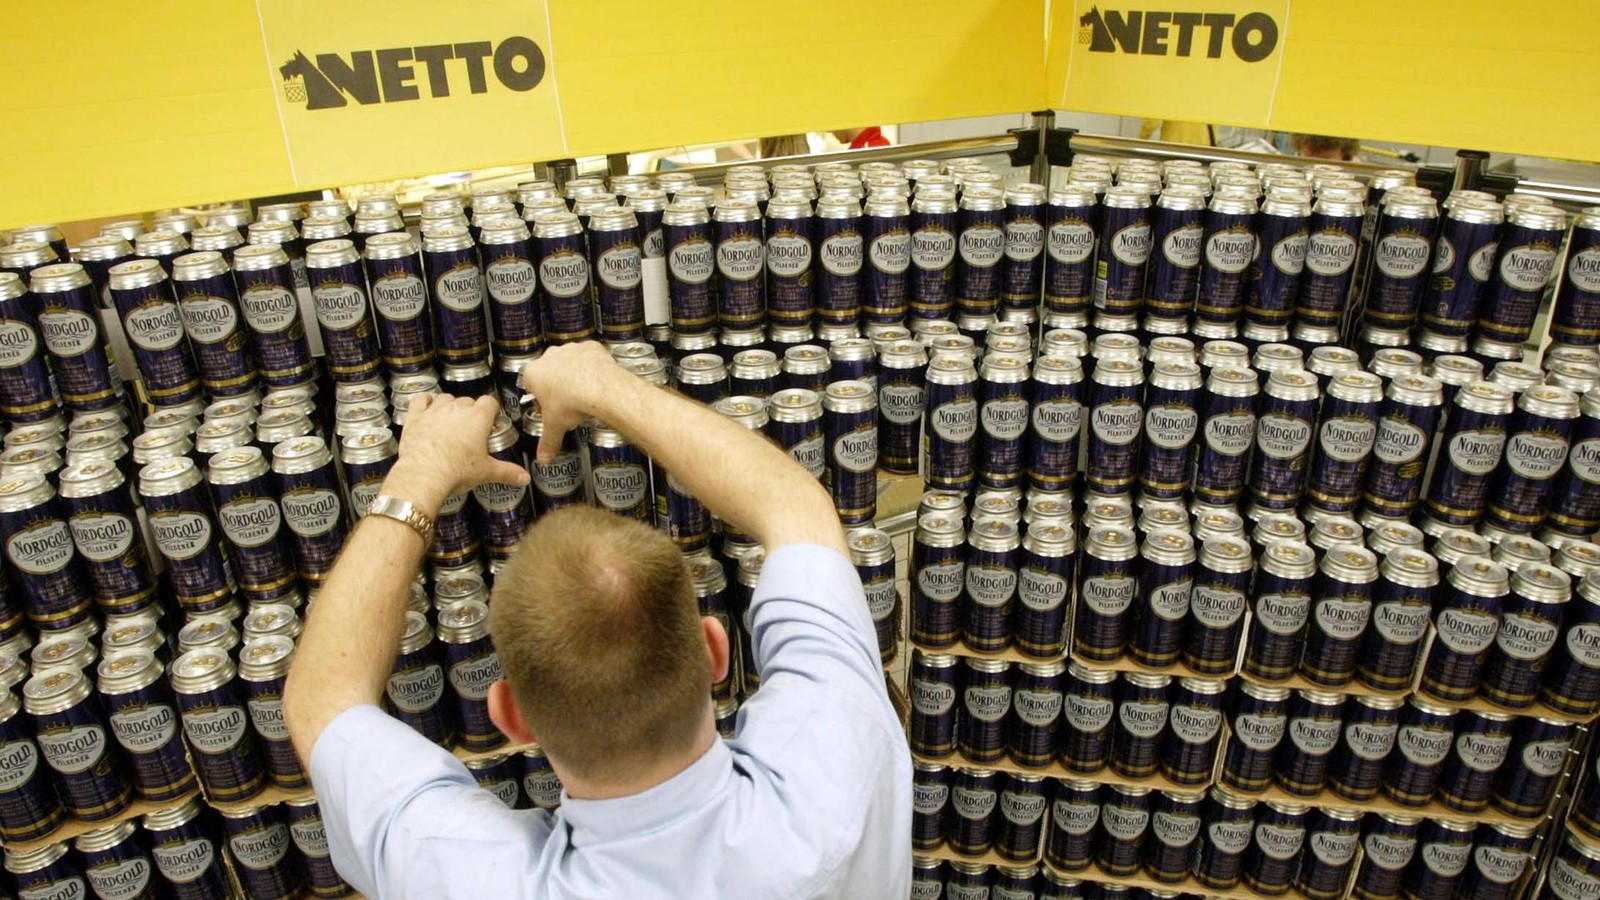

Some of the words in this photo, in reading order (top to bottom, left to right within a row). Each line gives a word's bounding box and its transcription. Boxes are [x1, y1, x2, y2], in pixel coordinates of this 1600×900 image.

[1104, 11, 1278, 62] NETTO
[316, 36, 545, 105] NETTO
[913, 237, 953, 251] NORDGOLD
[963, 235, 1002, 248] NORDGOLD
[1051, 230, 1091, 244] NORDGOLD
[720, 247, 761, 261] NORDGOLD
[1380, 242, 1427, 258] NORDGOLD
[489, 267, 532, 286] NORDGOLD
[543, 261, 585, 278] NORDGOLD
[376, 282, 422, 301] NORDGOLD
[131, 308, 179, 331] NORDGOLD
[883, 392, 924, 407] NORDGOLD
[986, 406, 1028, 421] NORDGOLD
[1038, 408, 1080, 421] NORDGOLD
[1150, 413, 1196, 429] NORDGOLD
[1514, 438, 1566, 459] NORDGOLD
[284, 495, 334, 516] NORDGOLD
[222, 503, 276, 527] NORDGOLD
[14, 526, 70, 557] NORDGOLD
[969, 572, 1014, 589] NORDGOLD
[1195, 591, 1241, 610] NORDGOLD
[1444, 613, 1496, 636] NORDGOLD
[391, 664, 442, 695] NORDGOLD
[969, 690, 1010, 706] NORDGOLD
[1019, 694, 1060, 710] NORDGOLD
[1069, 699, 1110, 717] NORDGOLD
[113, 709, 170, 734] NORDGOLD
[1175, 709, 1219, 727] NORDGOLD
[956, 792, 994, 805] NORDGOLD
[1004, 793, 1044, 810] NORDGOLD
[1057, 803, 1098, 820] NORDGOLD
[1104, 807, 1147, 825] NORDGOLD
[1155, 815, 1199, 832] NORDGOLD
[234, 826, 286, 852] NORDGOLD
